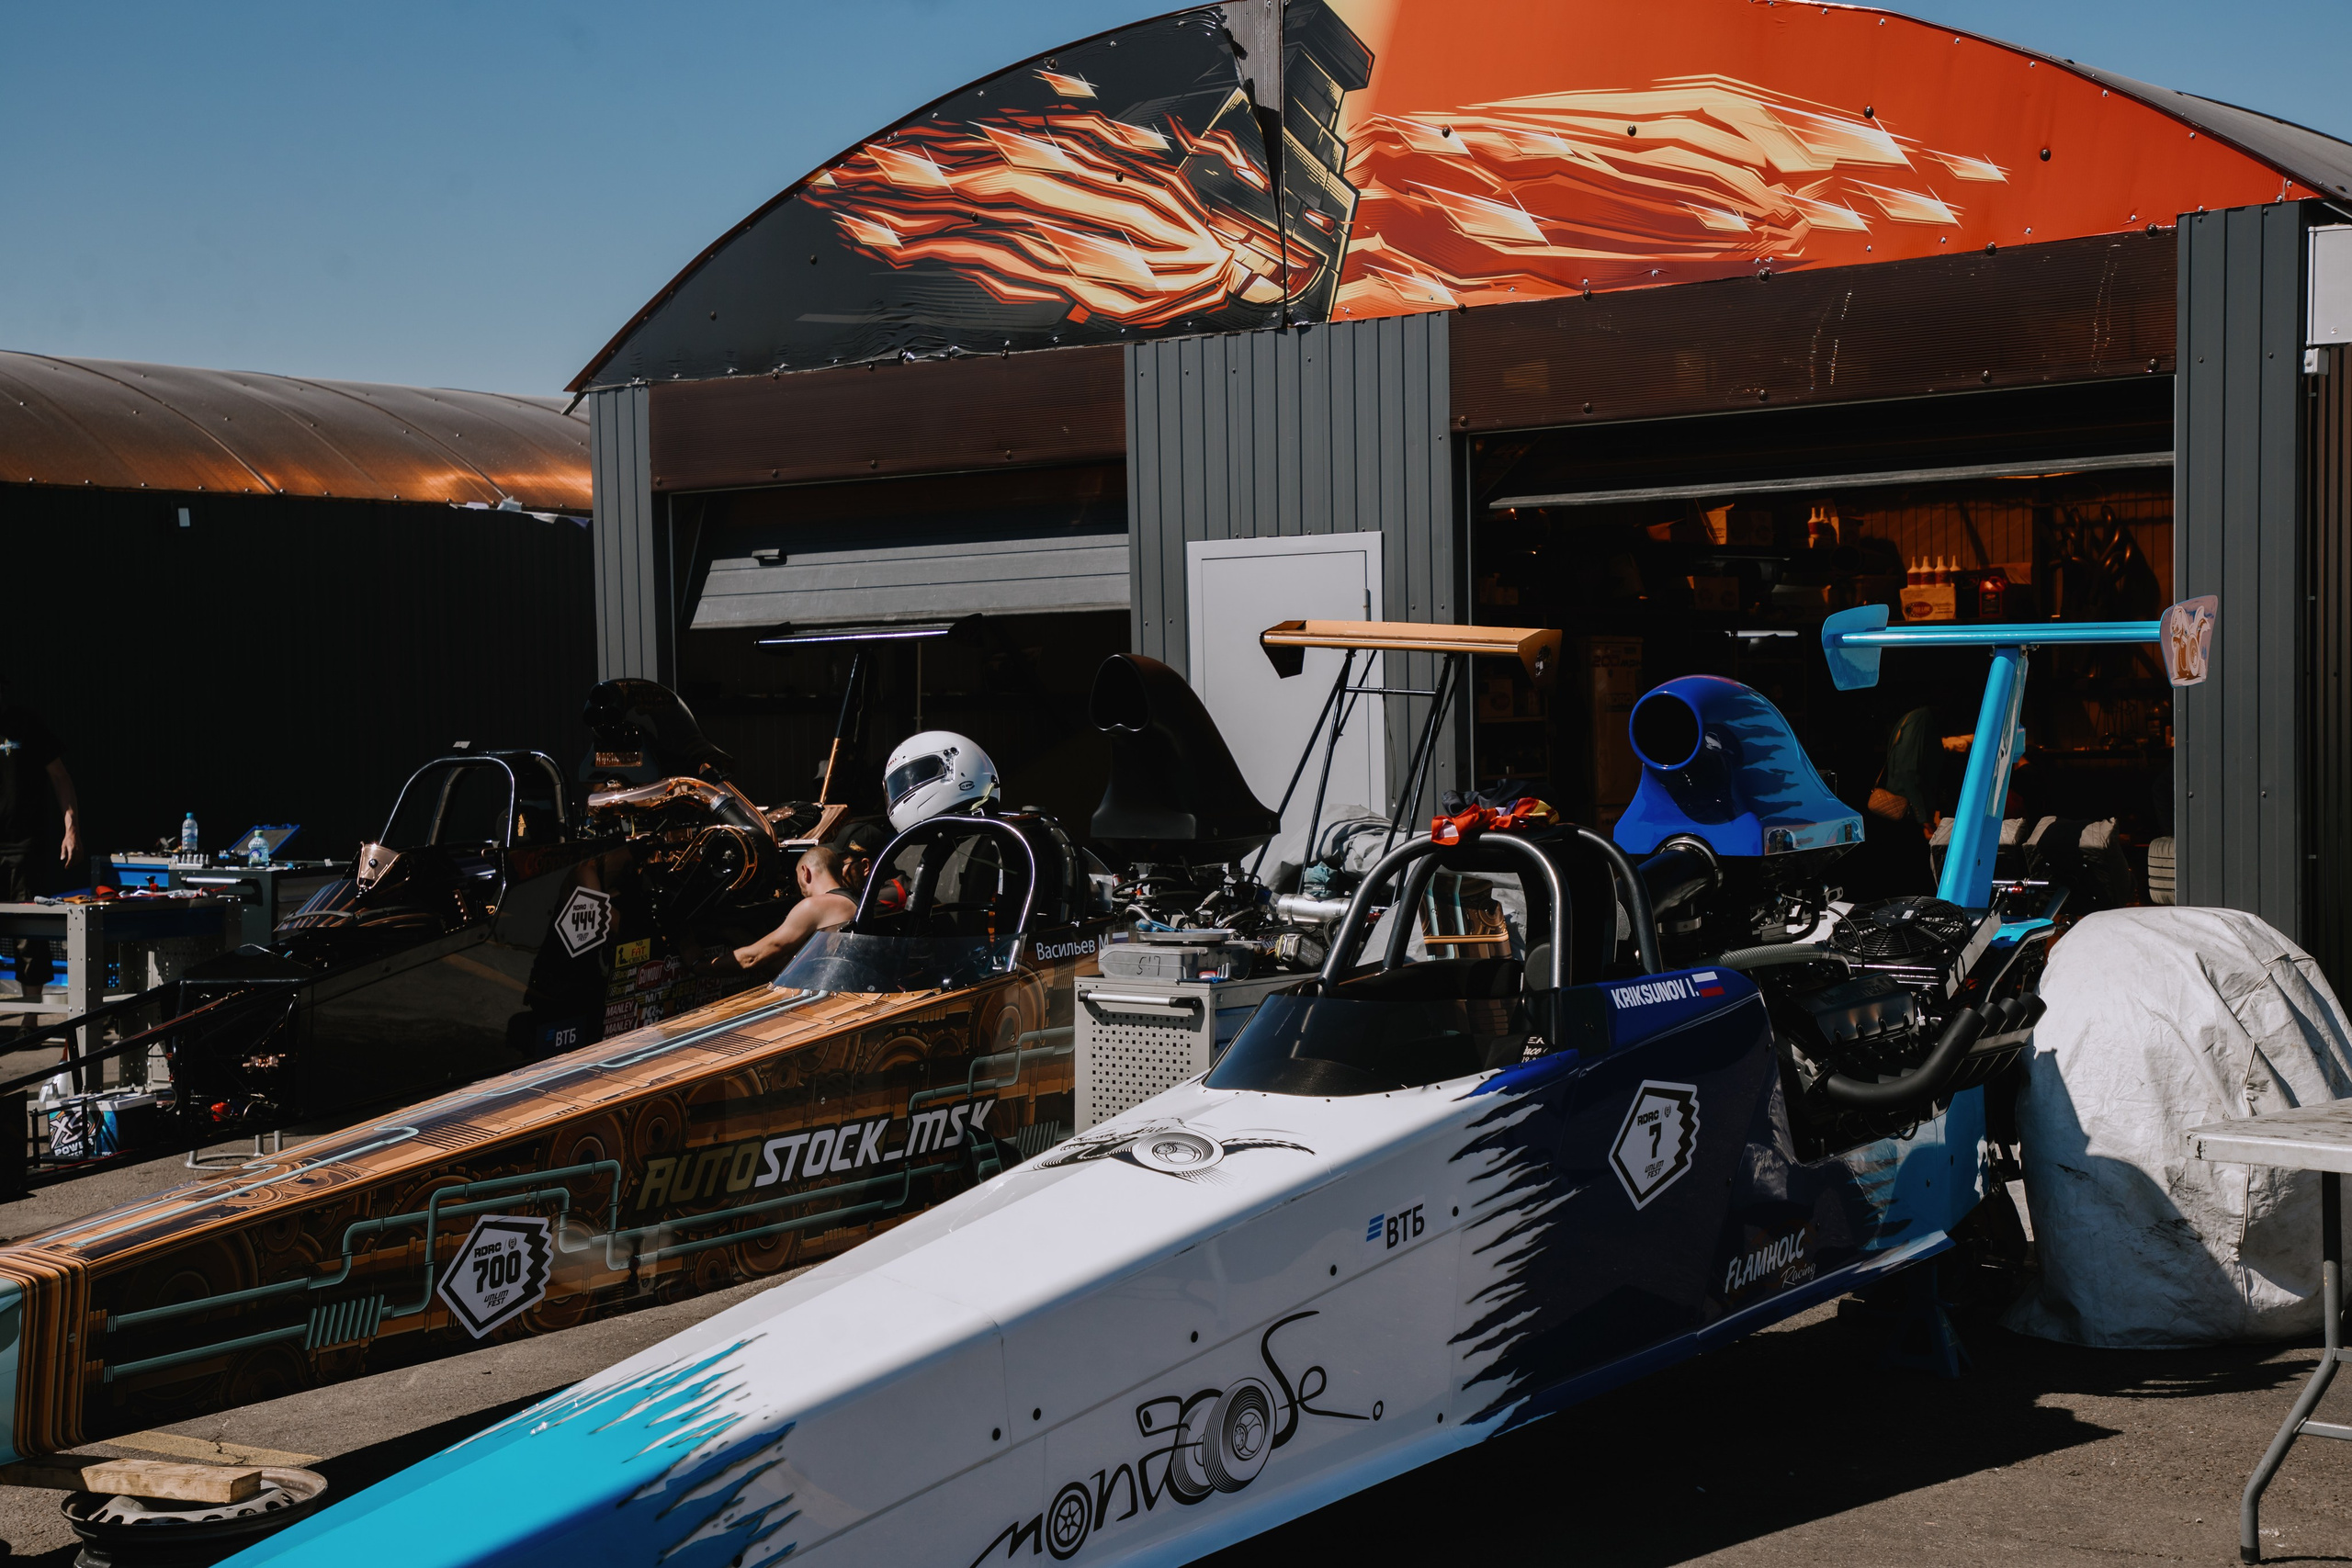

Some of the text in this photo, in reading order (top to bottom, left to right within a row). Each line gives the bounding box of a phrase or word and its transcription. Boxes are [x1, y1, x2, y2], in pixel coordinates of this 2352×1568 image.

[571, 910, 596, 932] 444
[631, 946, 646, 957] FAT
[1035, 939, 1096, 961] Васильев
[638, 964, 663, 985] GUMOUT
[1611, 979, 1687, 1009] KRIKSUNOV
[605, 1000, 634, 1017] MANLEY
[604, 1017, 634, 1035] MANLEY
[555, 1028, 577, 1047] ВТБ
[1649, 1122, 1661, 1159] 7
[1386, 1203, 1425, 1250] ВТБ
[473, 1249, 522, 1293] 700
[1724, 1227, 1805, 1294] FLAMHOLC
[1781, 1263, 1816, 1289] Racing
